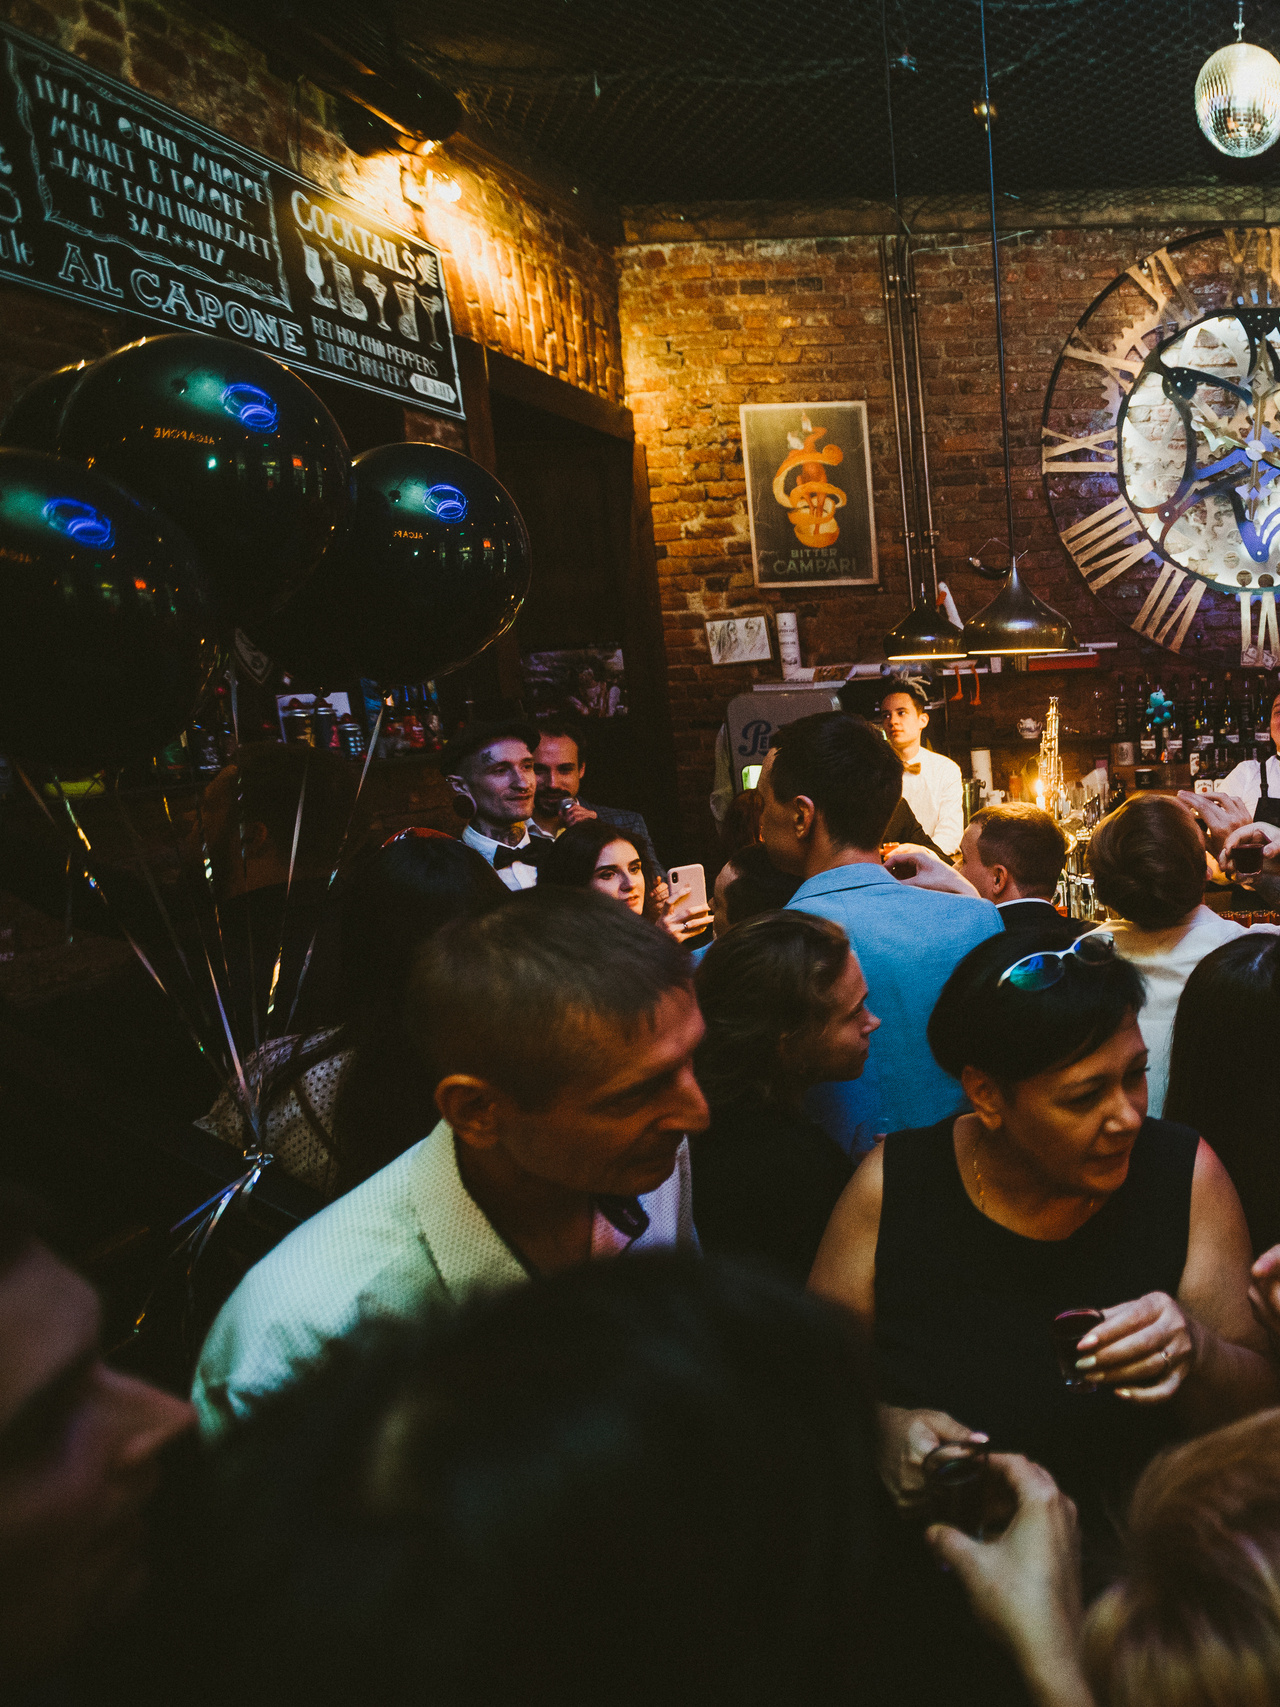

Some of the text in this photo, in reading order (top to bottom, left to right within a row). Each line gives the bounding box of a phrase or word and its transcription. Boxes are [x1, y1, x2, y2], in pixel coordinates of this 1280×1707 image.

[50, 116, 136, 173] МЕНЯЕТ
[148, 158, 163, 184] В
[118, 117, 181, 163] ОЧЕНЬ
[192, 152, 266, 205] МНОГОЕ
[50, 148, 272, 261] ДАЖЕ ЕСЛИ ПОПАДАЕТ
[90, 196, 105, 218] В
[58, 242, 307, 357] AL CAPONE
[385, 343, 438, 377] PEPPERS
[773, 558, 857, 575] CAMPARI
[791, 548, 838, 558] BITTER
